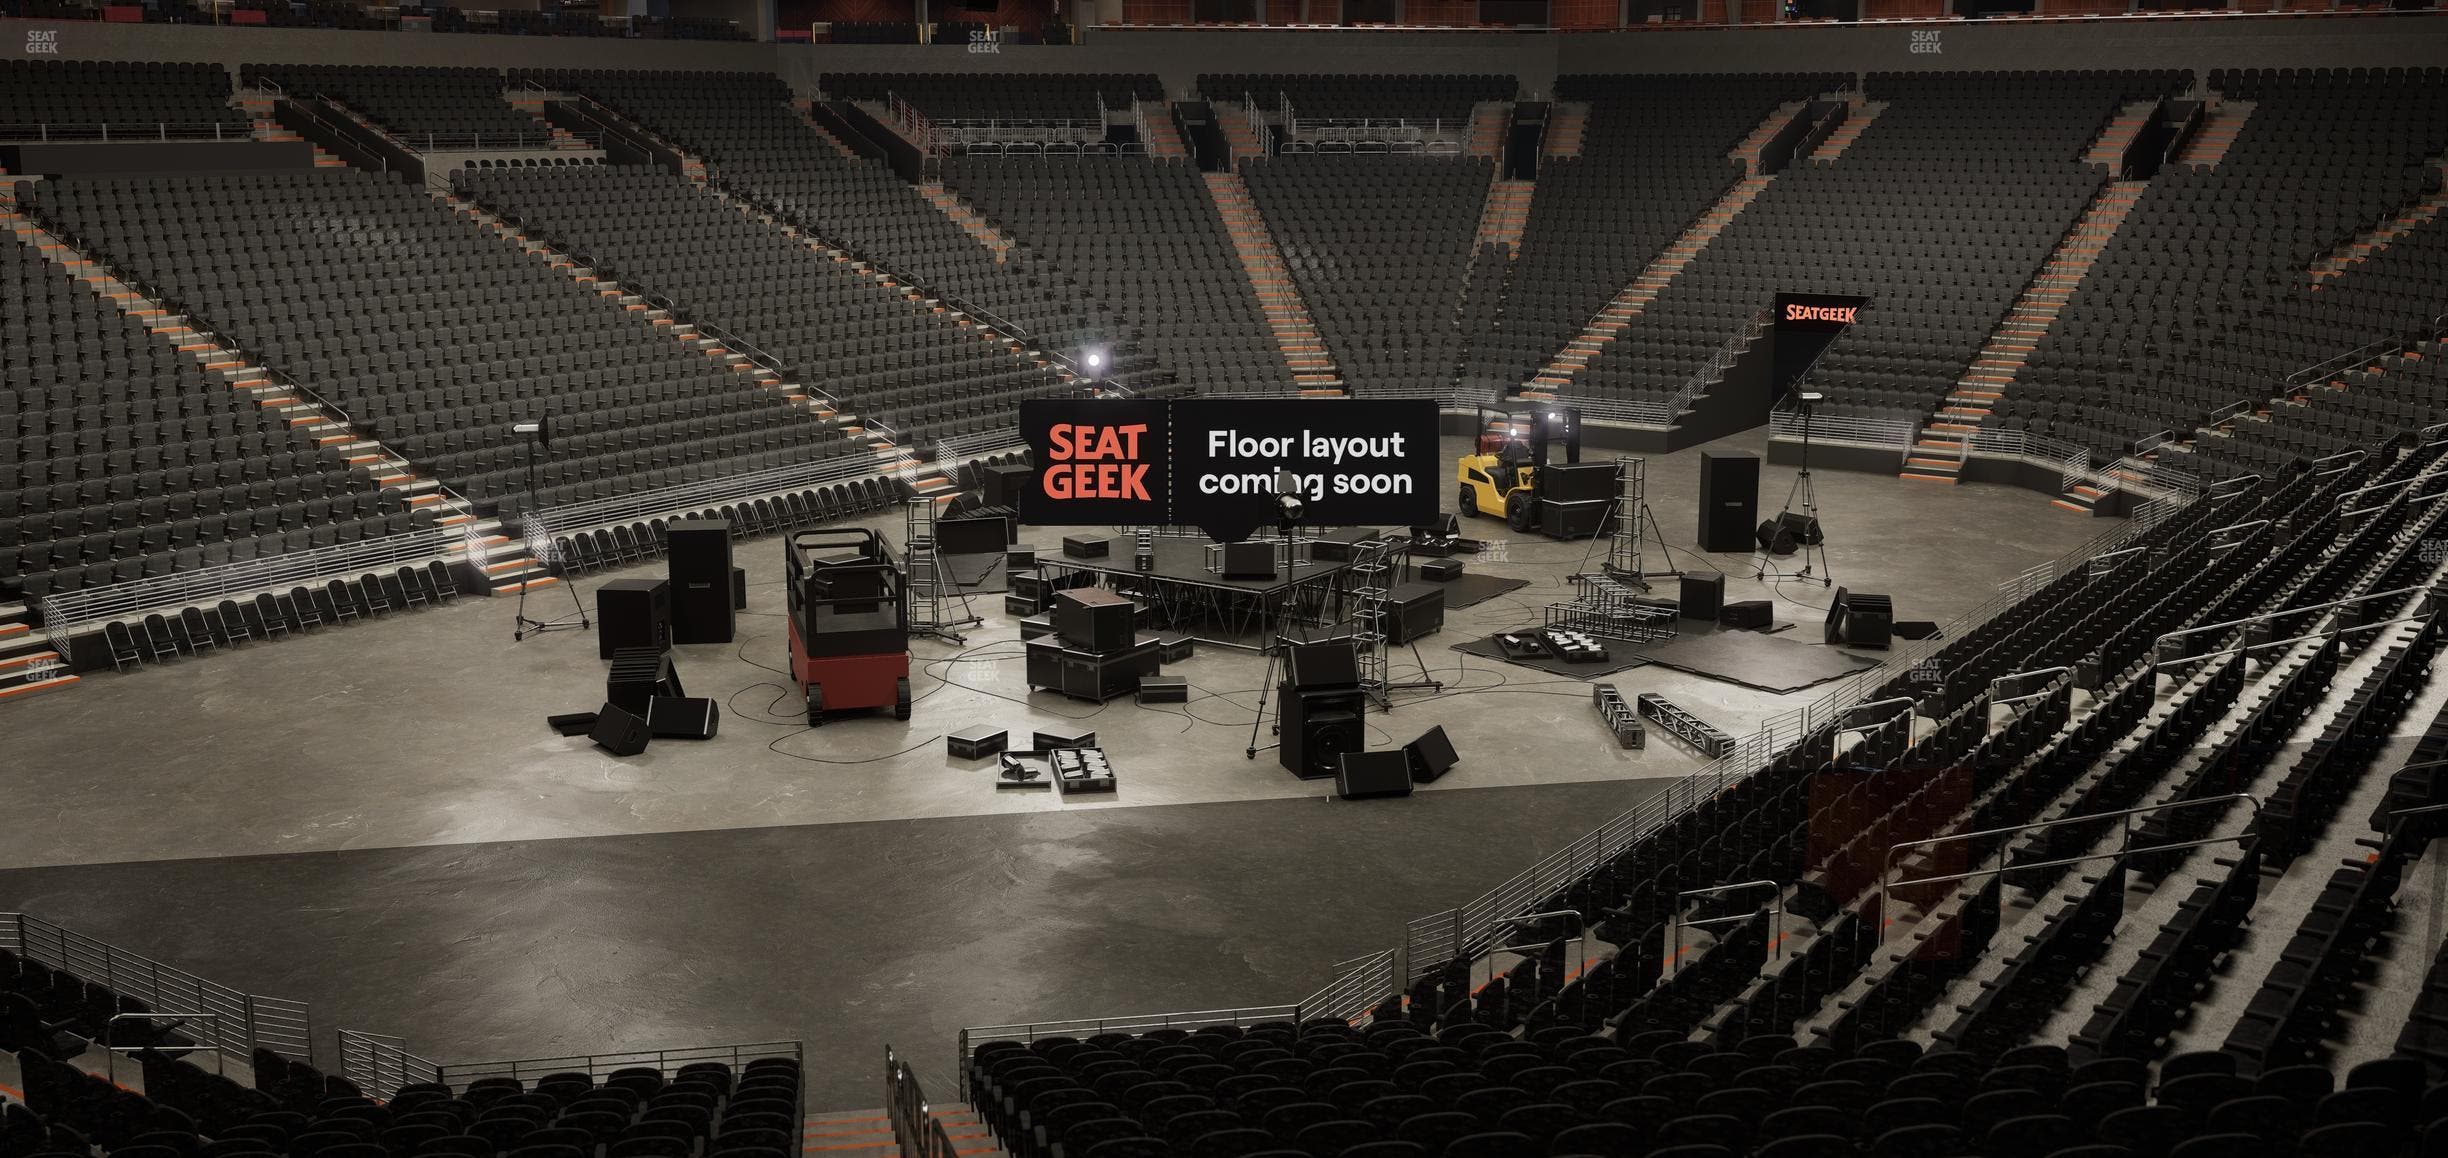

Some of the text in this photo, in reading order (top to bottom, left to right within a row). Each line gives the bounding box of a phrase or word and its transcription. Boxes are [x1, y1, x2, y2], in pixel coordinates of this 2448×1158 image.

[1786, 304, 1857, 325] SEATGEEK
[1049, 423, 1148, 461] SEAT
[1208, 429, 1405, 465] Floor layout
[1043, 464, 1152, 501] GEEK
[1333, 473, 1413, 495] soon
